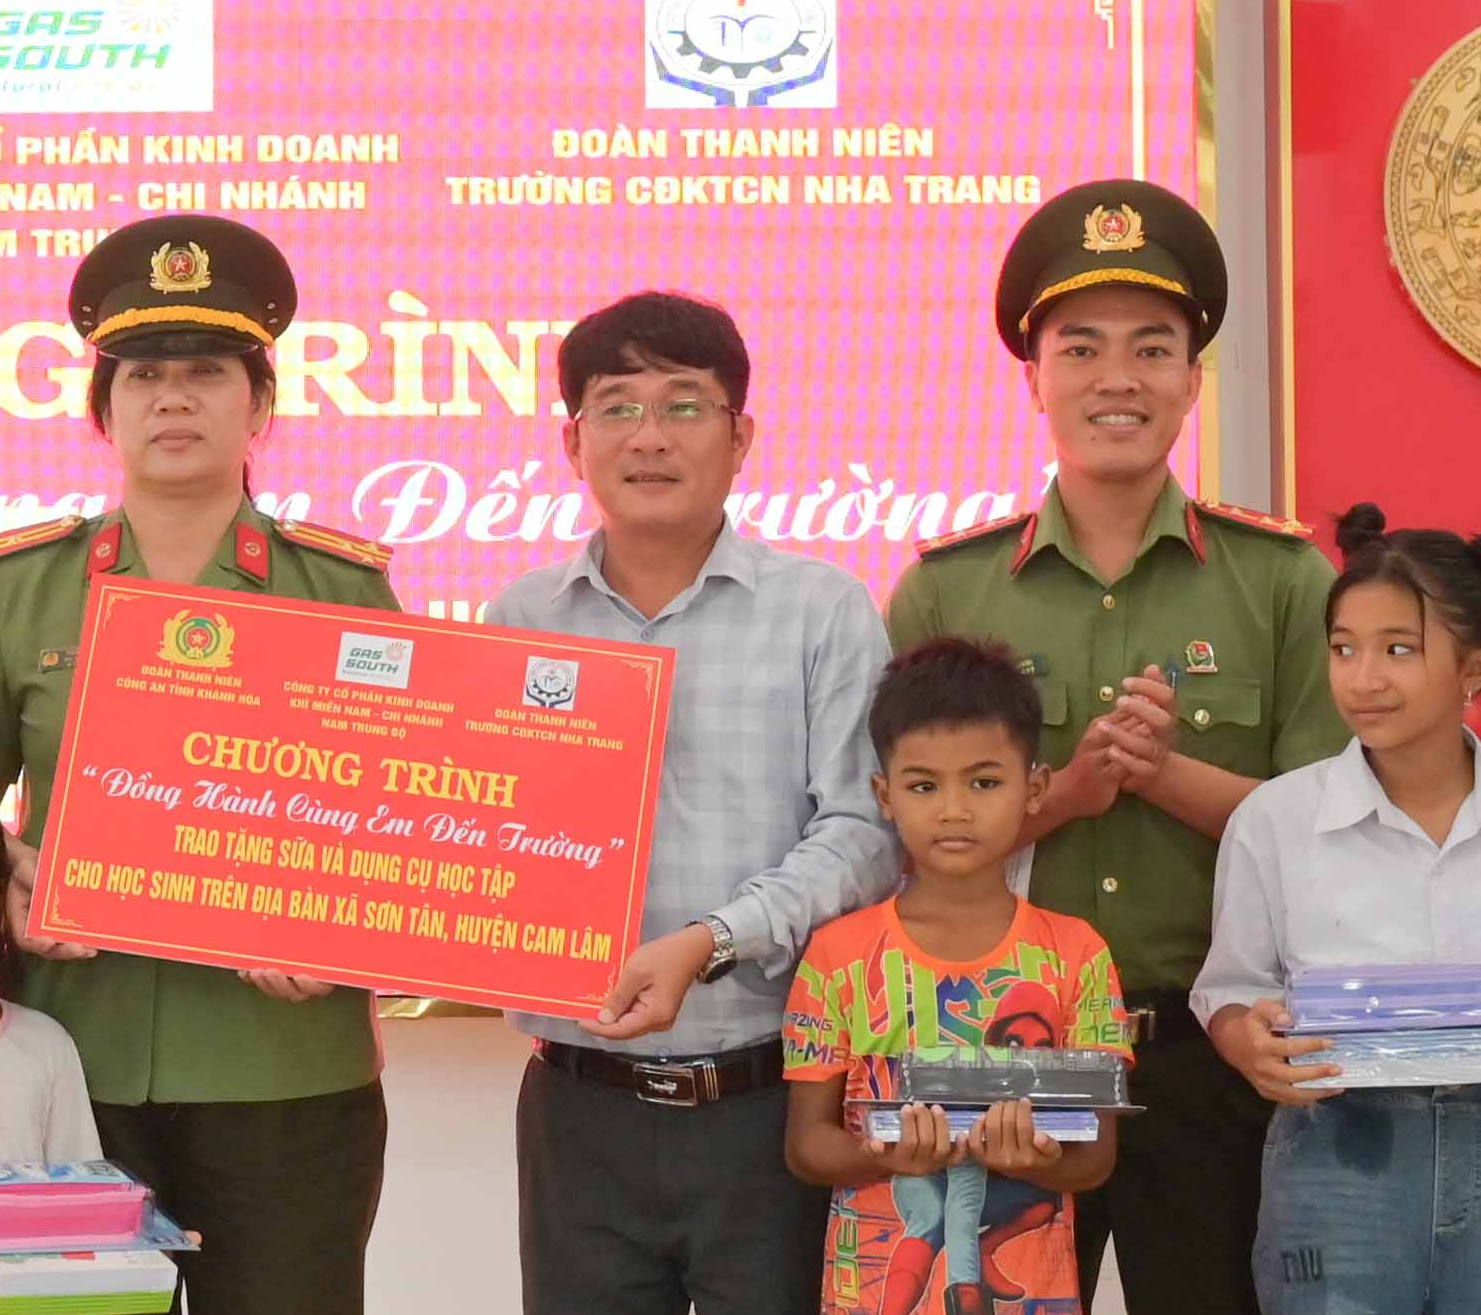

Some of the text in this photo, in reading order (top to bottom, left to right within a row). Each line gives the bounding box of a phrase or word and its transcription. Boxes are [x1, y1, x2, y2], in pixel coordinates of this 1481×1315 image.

[16, 126, 131, 164] PHẦN
[144, 135, 243, 163] KINH
[257, 134, 399, 163] DOANH
[552, 123, 934, 158] ĐOÀN THANH NIÊN
[138, 182, 205, 211] CHI
[221, 176, 366, 210] NHÁNH
[445, 170, 1040, 205] TRƯỜNG CĐKTCN NHA TRANG
[274, 290, 577, 418] RÌN
[352, 459, 597, 545] Đến
[344, 658, 399, 675] SOUTH
[349, 646, 383, 661] GAS
[116, 676, 148, 692] CÔNG
[149, 681, 166, 694] AN
[175, 668, 213, 685] THANH
[214, 675, 243, 688] NIÊN
[283, 680, 315, 695] CÔNG
[317, 685, 330, 698] TY
[385, 695, 414, 709] KINH
[416, 699, 456, 714] DOANH
[344, 704, 372, 718] NAM
[381, 710, 401, 722] CHI
[321, 716, 348, 731] NAM
[351, 721, 389, 737] TRUNG
[529, 712, 567, 729] THANH
[569, 717, 598, 732] NIÊN
[559, 731, 584, 747] NHA
[586, 735, 625, 751] TRANG
[182, 731, 520, 809] CHƯƠNG TRÌNH
[192, 778, 277, 819] Hành
[285, 792, 360, 836] Cùng
[365, 803, 415, 838] Em
[423, 812, 487, 848] Đến
[173, 823, 516, 904] TRAO TẶNG SỮA VÀ DỤNG CỤ HỌC TẬP
[64, 857, 613, 964] CHO HỌC SINH TRÊN ĐỊA BÀN XÃ SƠN TÂN, HUYỆN CAM LÂM
